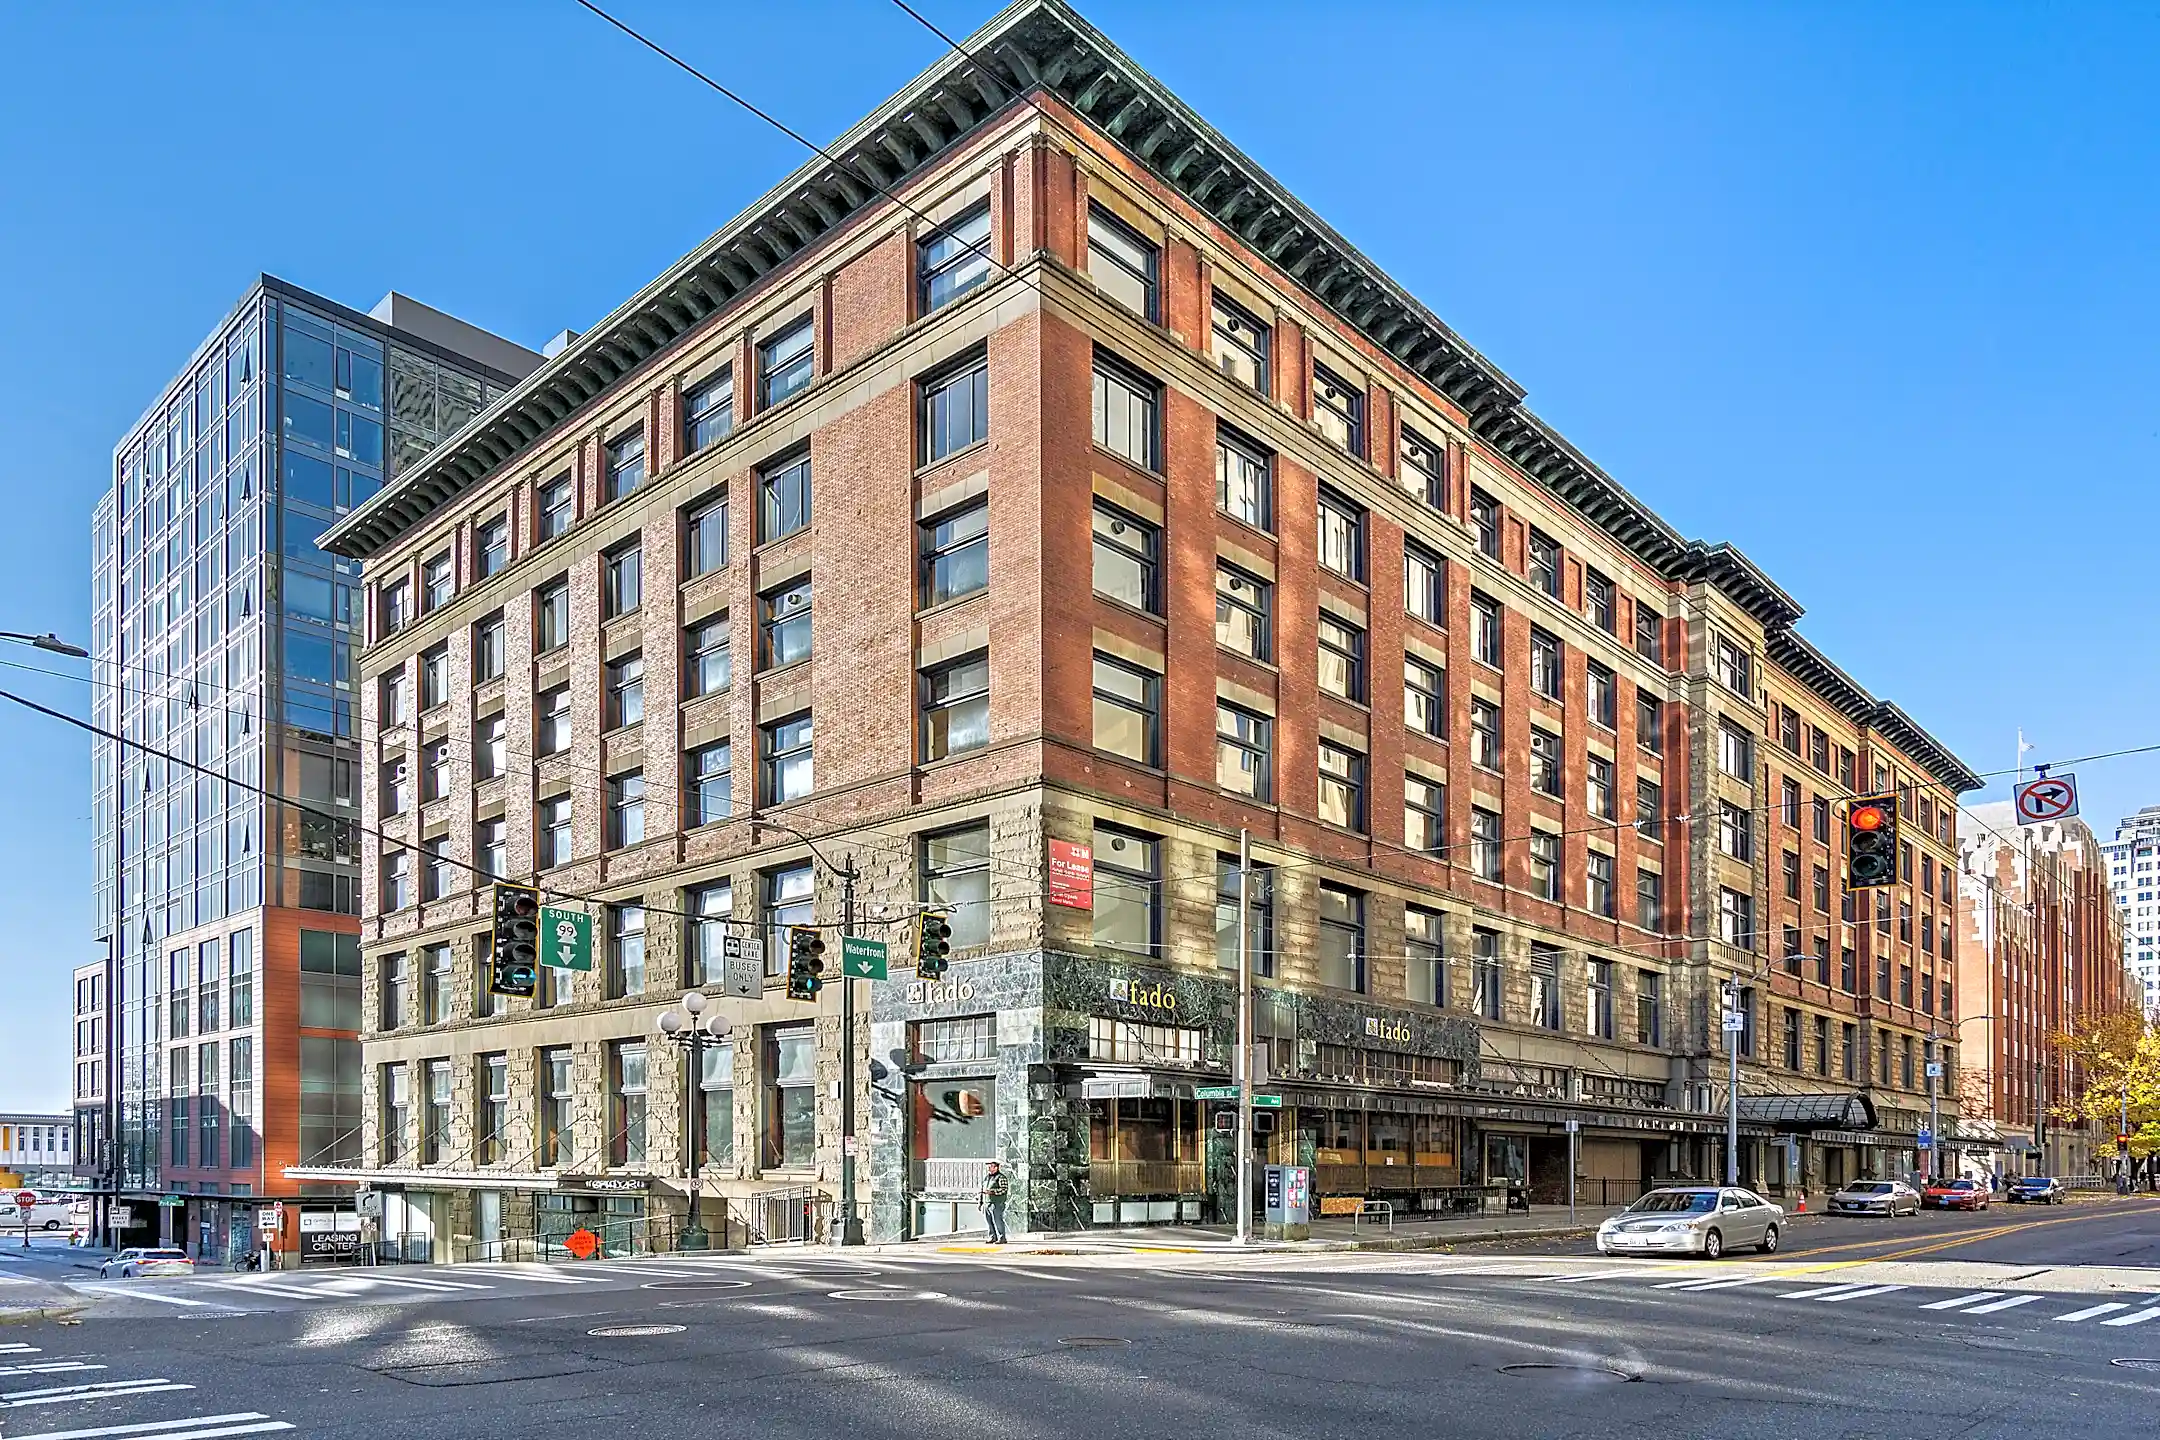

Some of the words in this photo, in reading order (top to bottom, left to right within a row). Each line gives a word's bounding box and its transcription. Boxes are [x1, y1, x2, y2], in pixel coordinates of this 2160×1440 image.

[1051, 857, 1066, 869] For
[1066, 861, 1090, 873] Lease
[548, 910, 584, 922] SOUTH
[558, 925, 574, 936] 99
[741, 940, 760, 950] CENTER
[845, 943, 884, 958] Waterfront
[743, 950, 759, 959] LANE
[729, 960, 758, 972] BUSES
[733, 972, 754, 983] ONLY
[1129, 978, 1176, 1010] fadó
[1380, 1017, 1410, 1041] fadó
[1196, 1089, 1225, 1099] Columbia
[311, 1233, 358, 1243] LEASING
